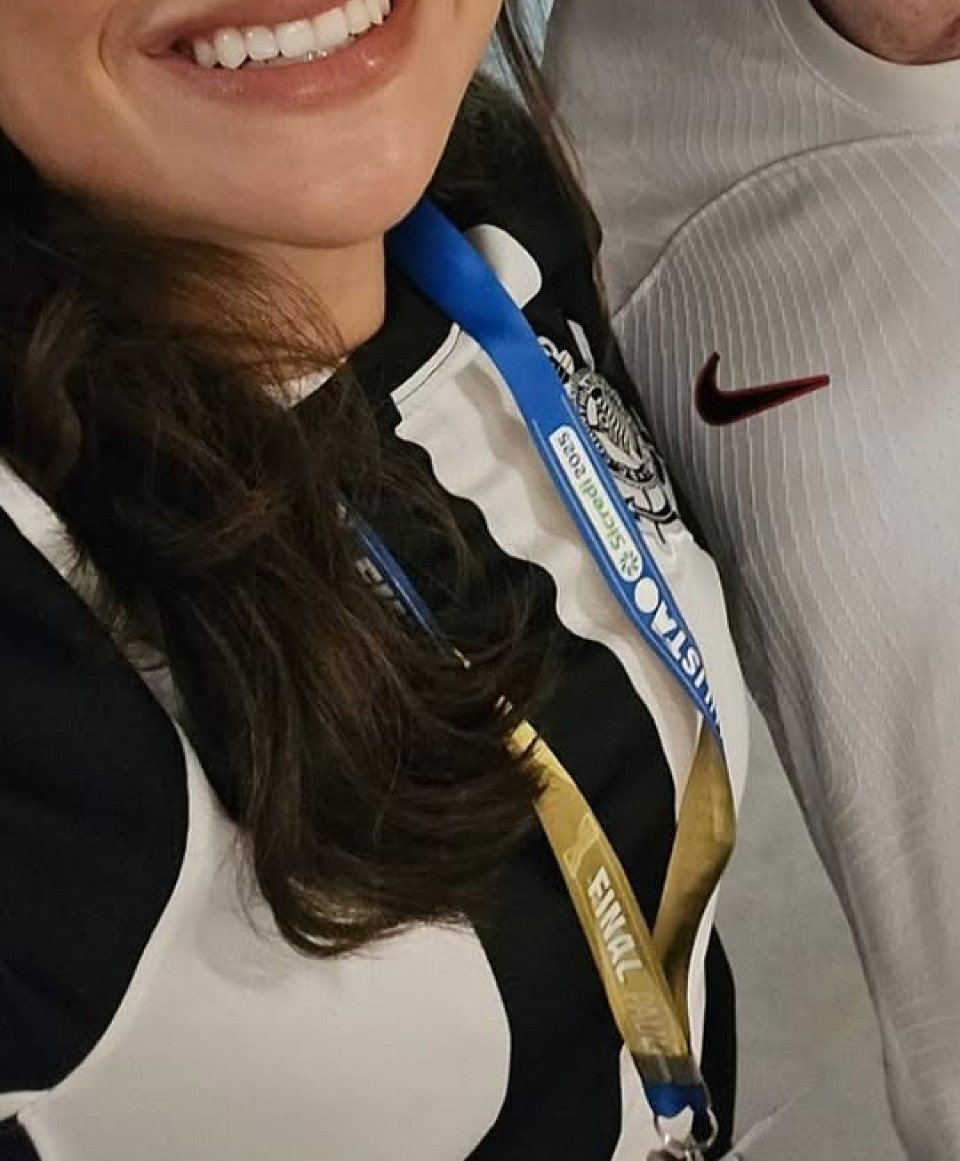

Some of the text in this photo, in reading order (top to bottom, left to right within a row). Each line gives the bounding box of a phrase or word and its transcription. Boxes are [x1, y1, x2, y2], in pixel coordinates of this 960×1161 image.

[557, 431, 587, 479] 2025
[579, 477, 627, 551] Sicredi
[587, 866, 644, 983] FINAL
